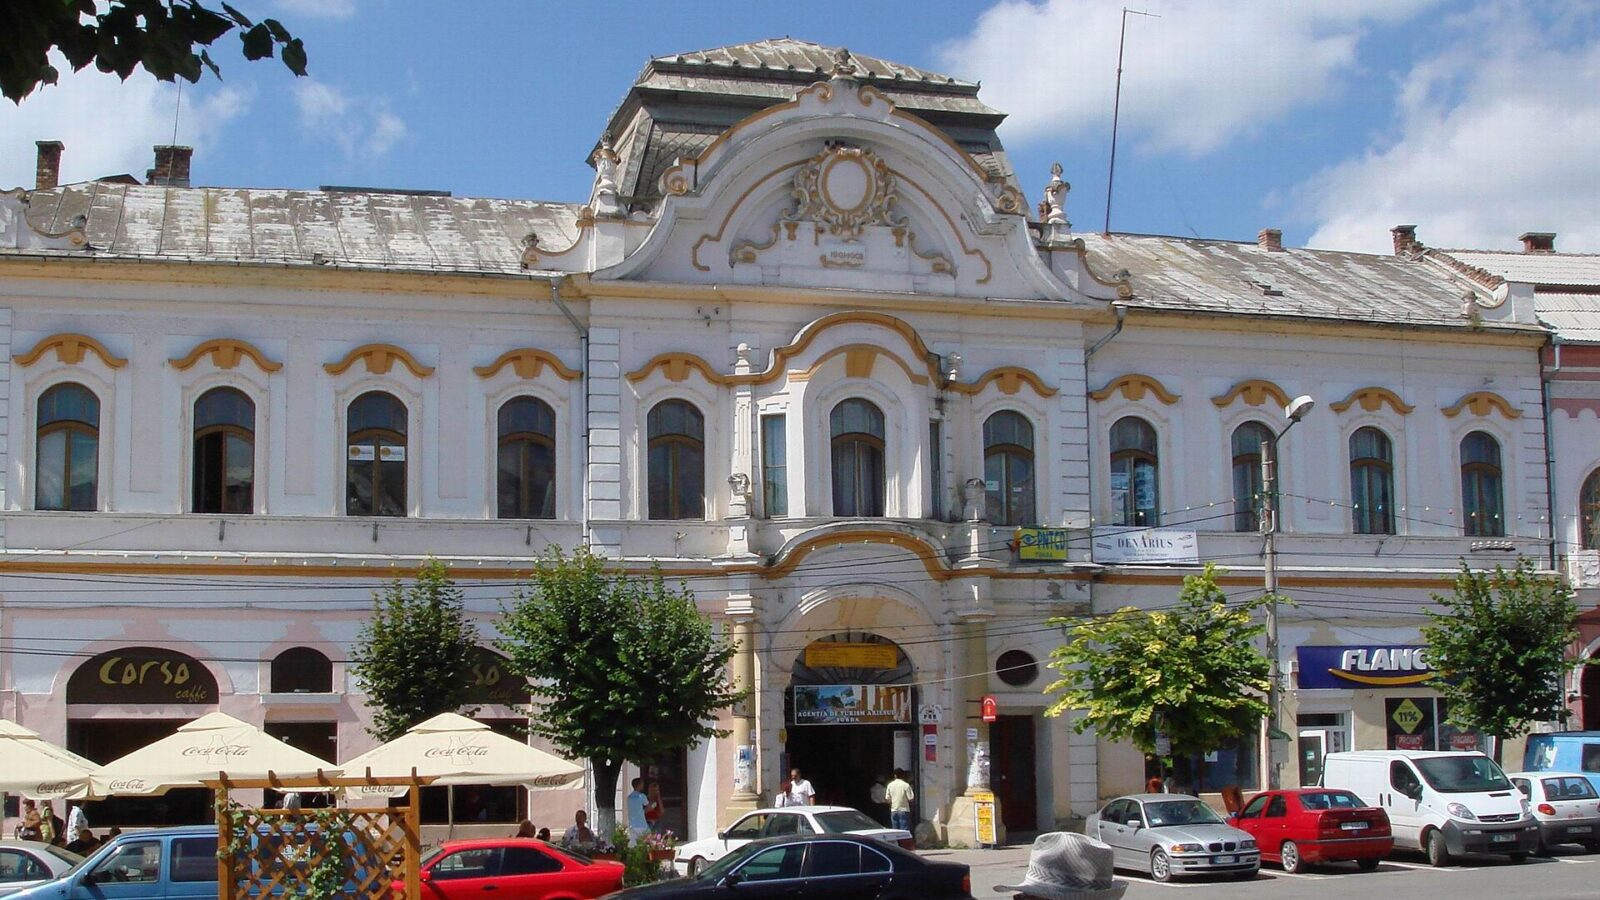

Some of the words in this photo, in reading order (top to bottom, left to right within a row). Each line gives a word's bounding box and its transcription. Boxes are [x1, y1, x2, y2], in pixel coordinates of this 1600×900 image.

[1037, 530, 1067, 550] PNTCD
[99, 657, 190, 685] Corso
[1398, 711, 1418, 722] 11%
